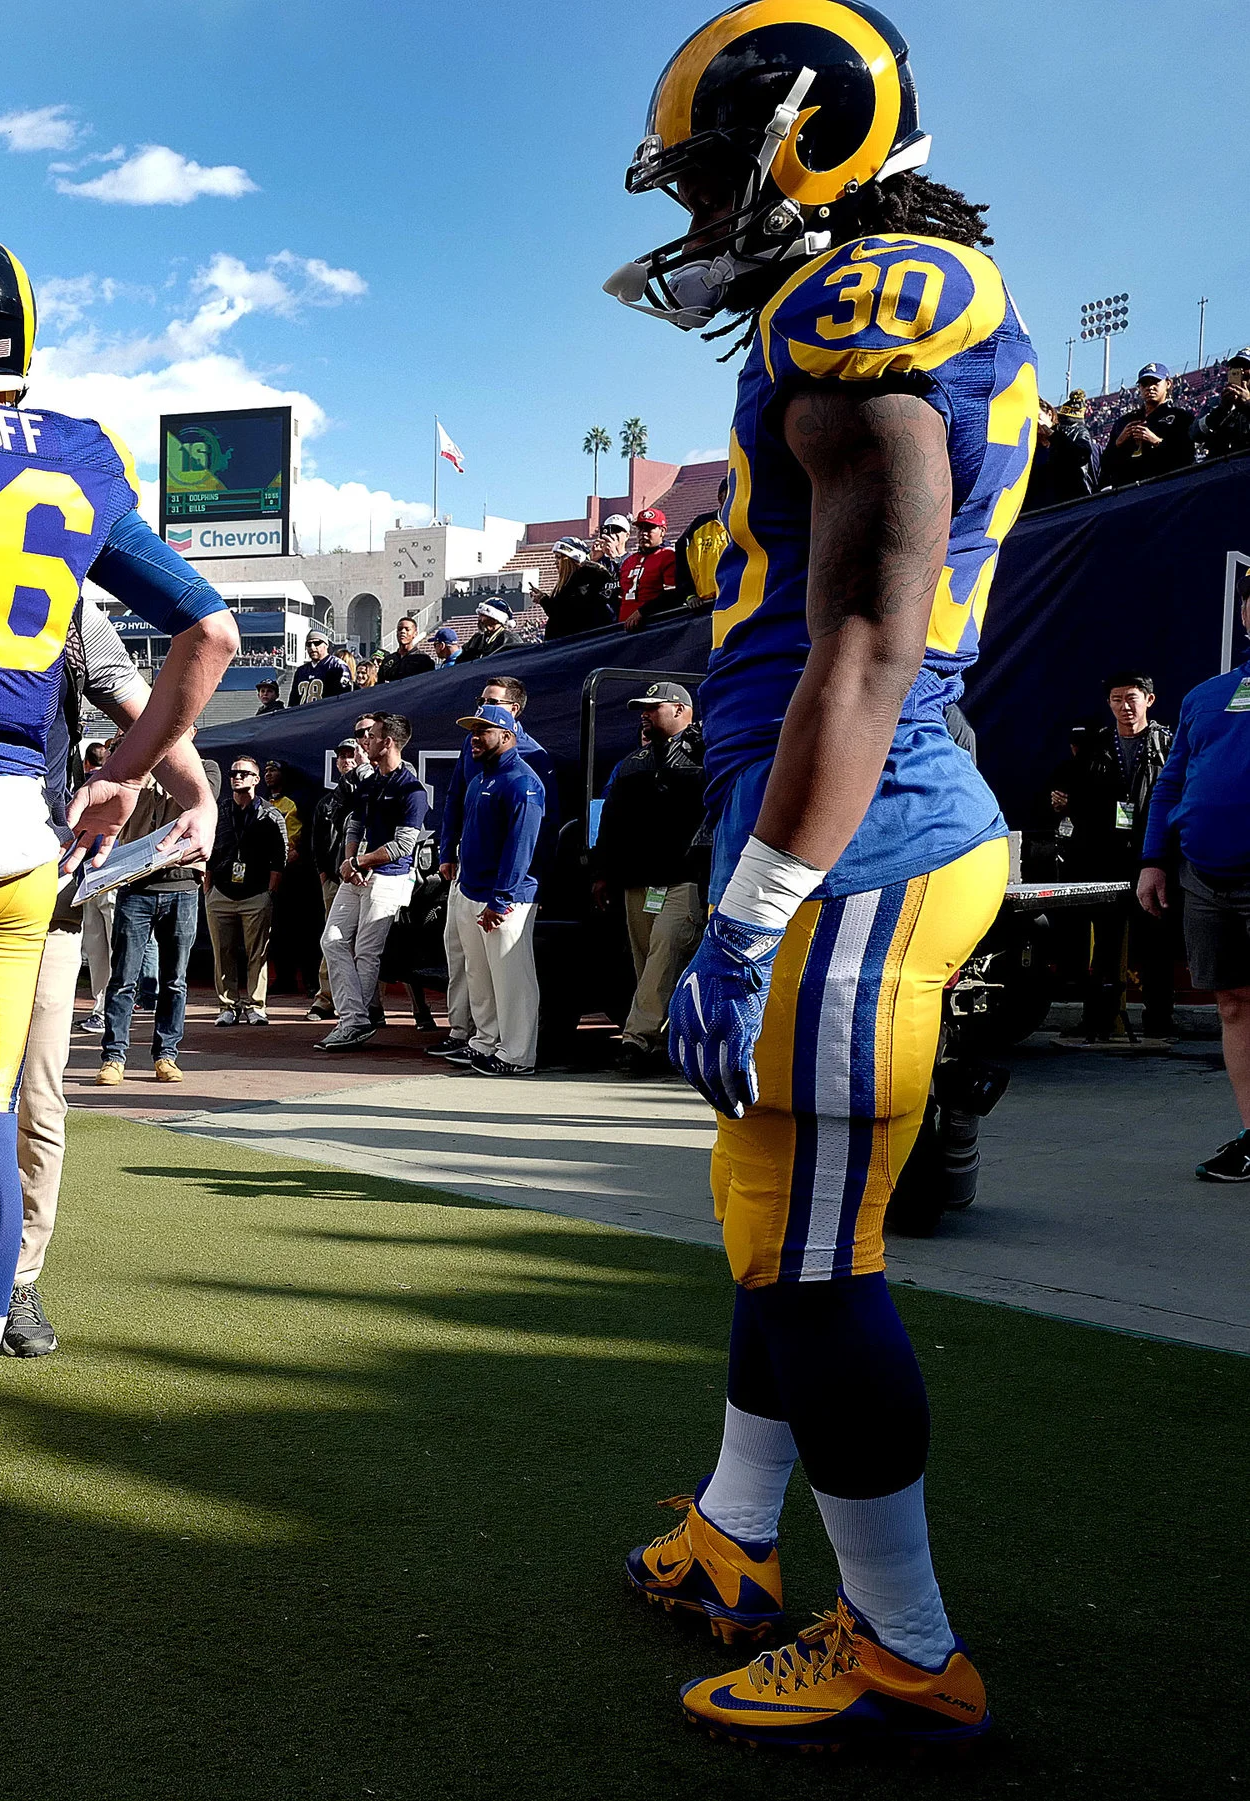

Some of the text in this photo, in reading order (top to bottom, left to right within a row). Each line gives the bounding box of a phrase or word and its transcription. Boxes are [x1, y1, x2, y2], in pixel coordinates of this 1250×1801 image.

[815, 260, 946, 340] 30
[171, 495, 180, 503] 31
[189, 493, 219, 502] DOLPHINS
[200, 526, 280, 548] Chevron
[128, 621, 153, 630] HYUN
